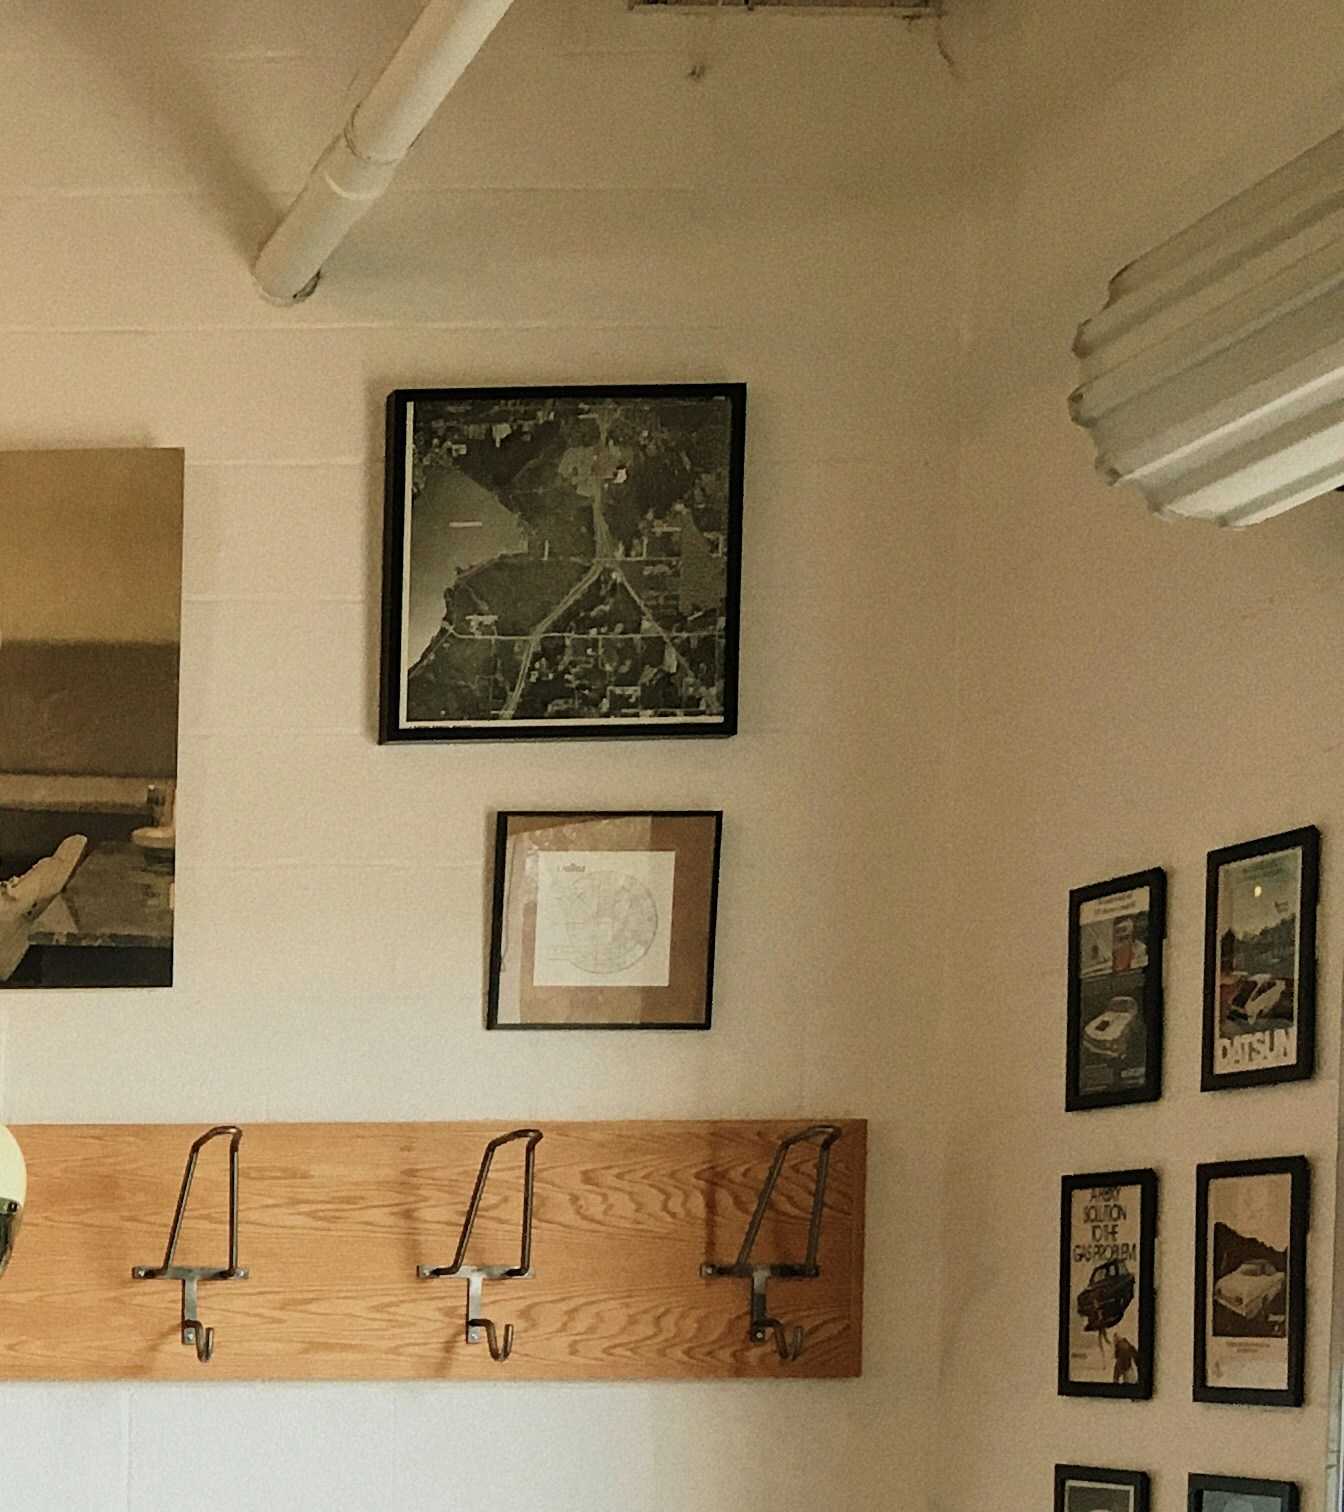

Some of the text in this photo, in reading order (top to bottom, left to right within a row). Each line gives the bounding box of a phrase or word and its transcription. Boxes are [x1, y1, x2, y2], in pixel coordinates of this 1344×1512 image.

[1217, 1027, 1295, 1066] DATSUN
[1073, 1243, 1137, 1262] GAS PROBLEM
